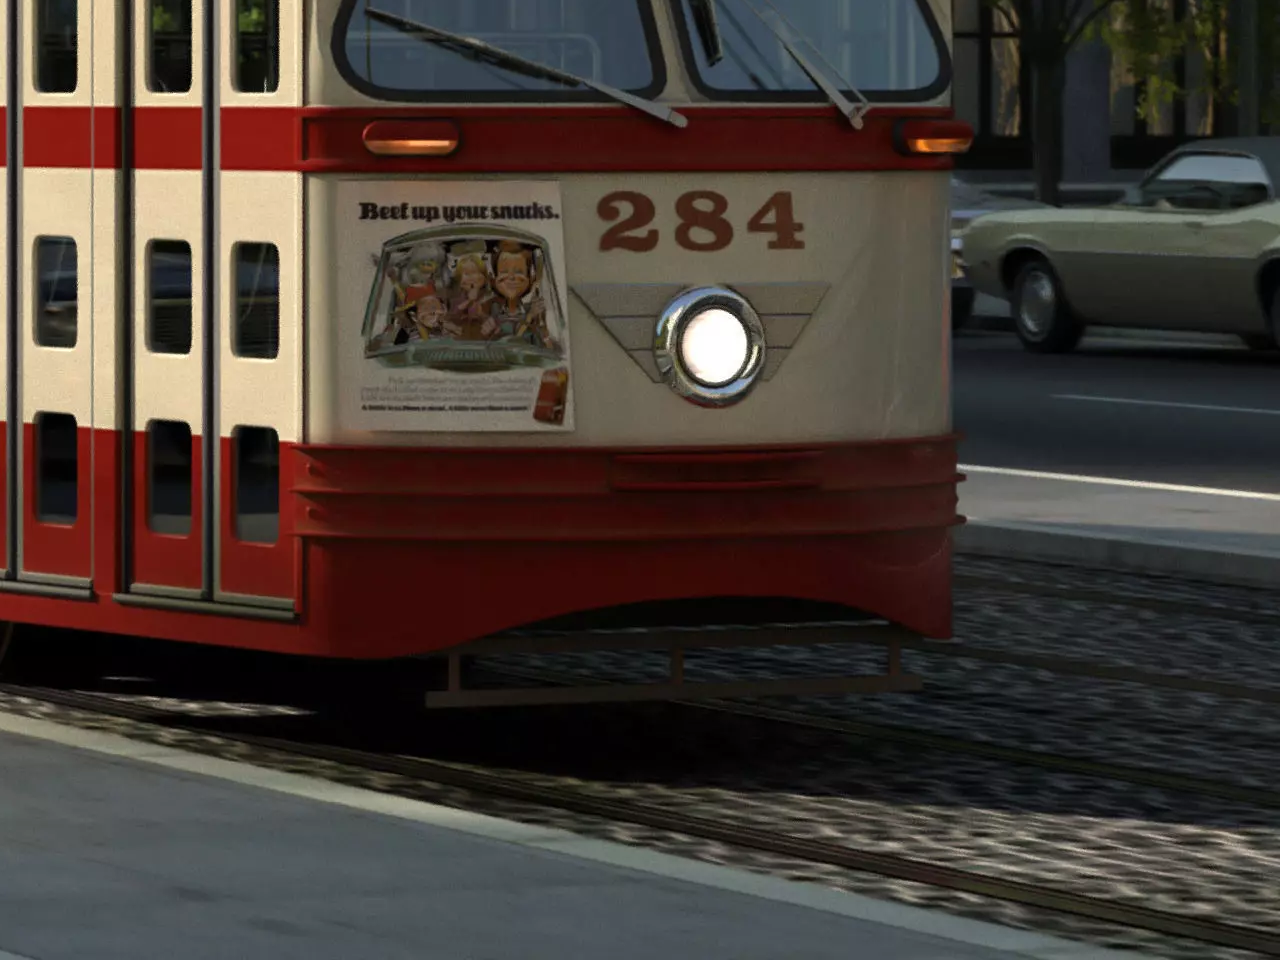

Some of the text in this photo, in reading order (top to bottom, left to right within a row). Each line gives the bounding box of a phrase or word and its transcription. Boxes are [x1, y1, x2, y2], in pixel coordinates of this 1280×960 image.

[359, 201, 559, 223] Beef up your snacks.
[596, 190, 805, 253] 284
